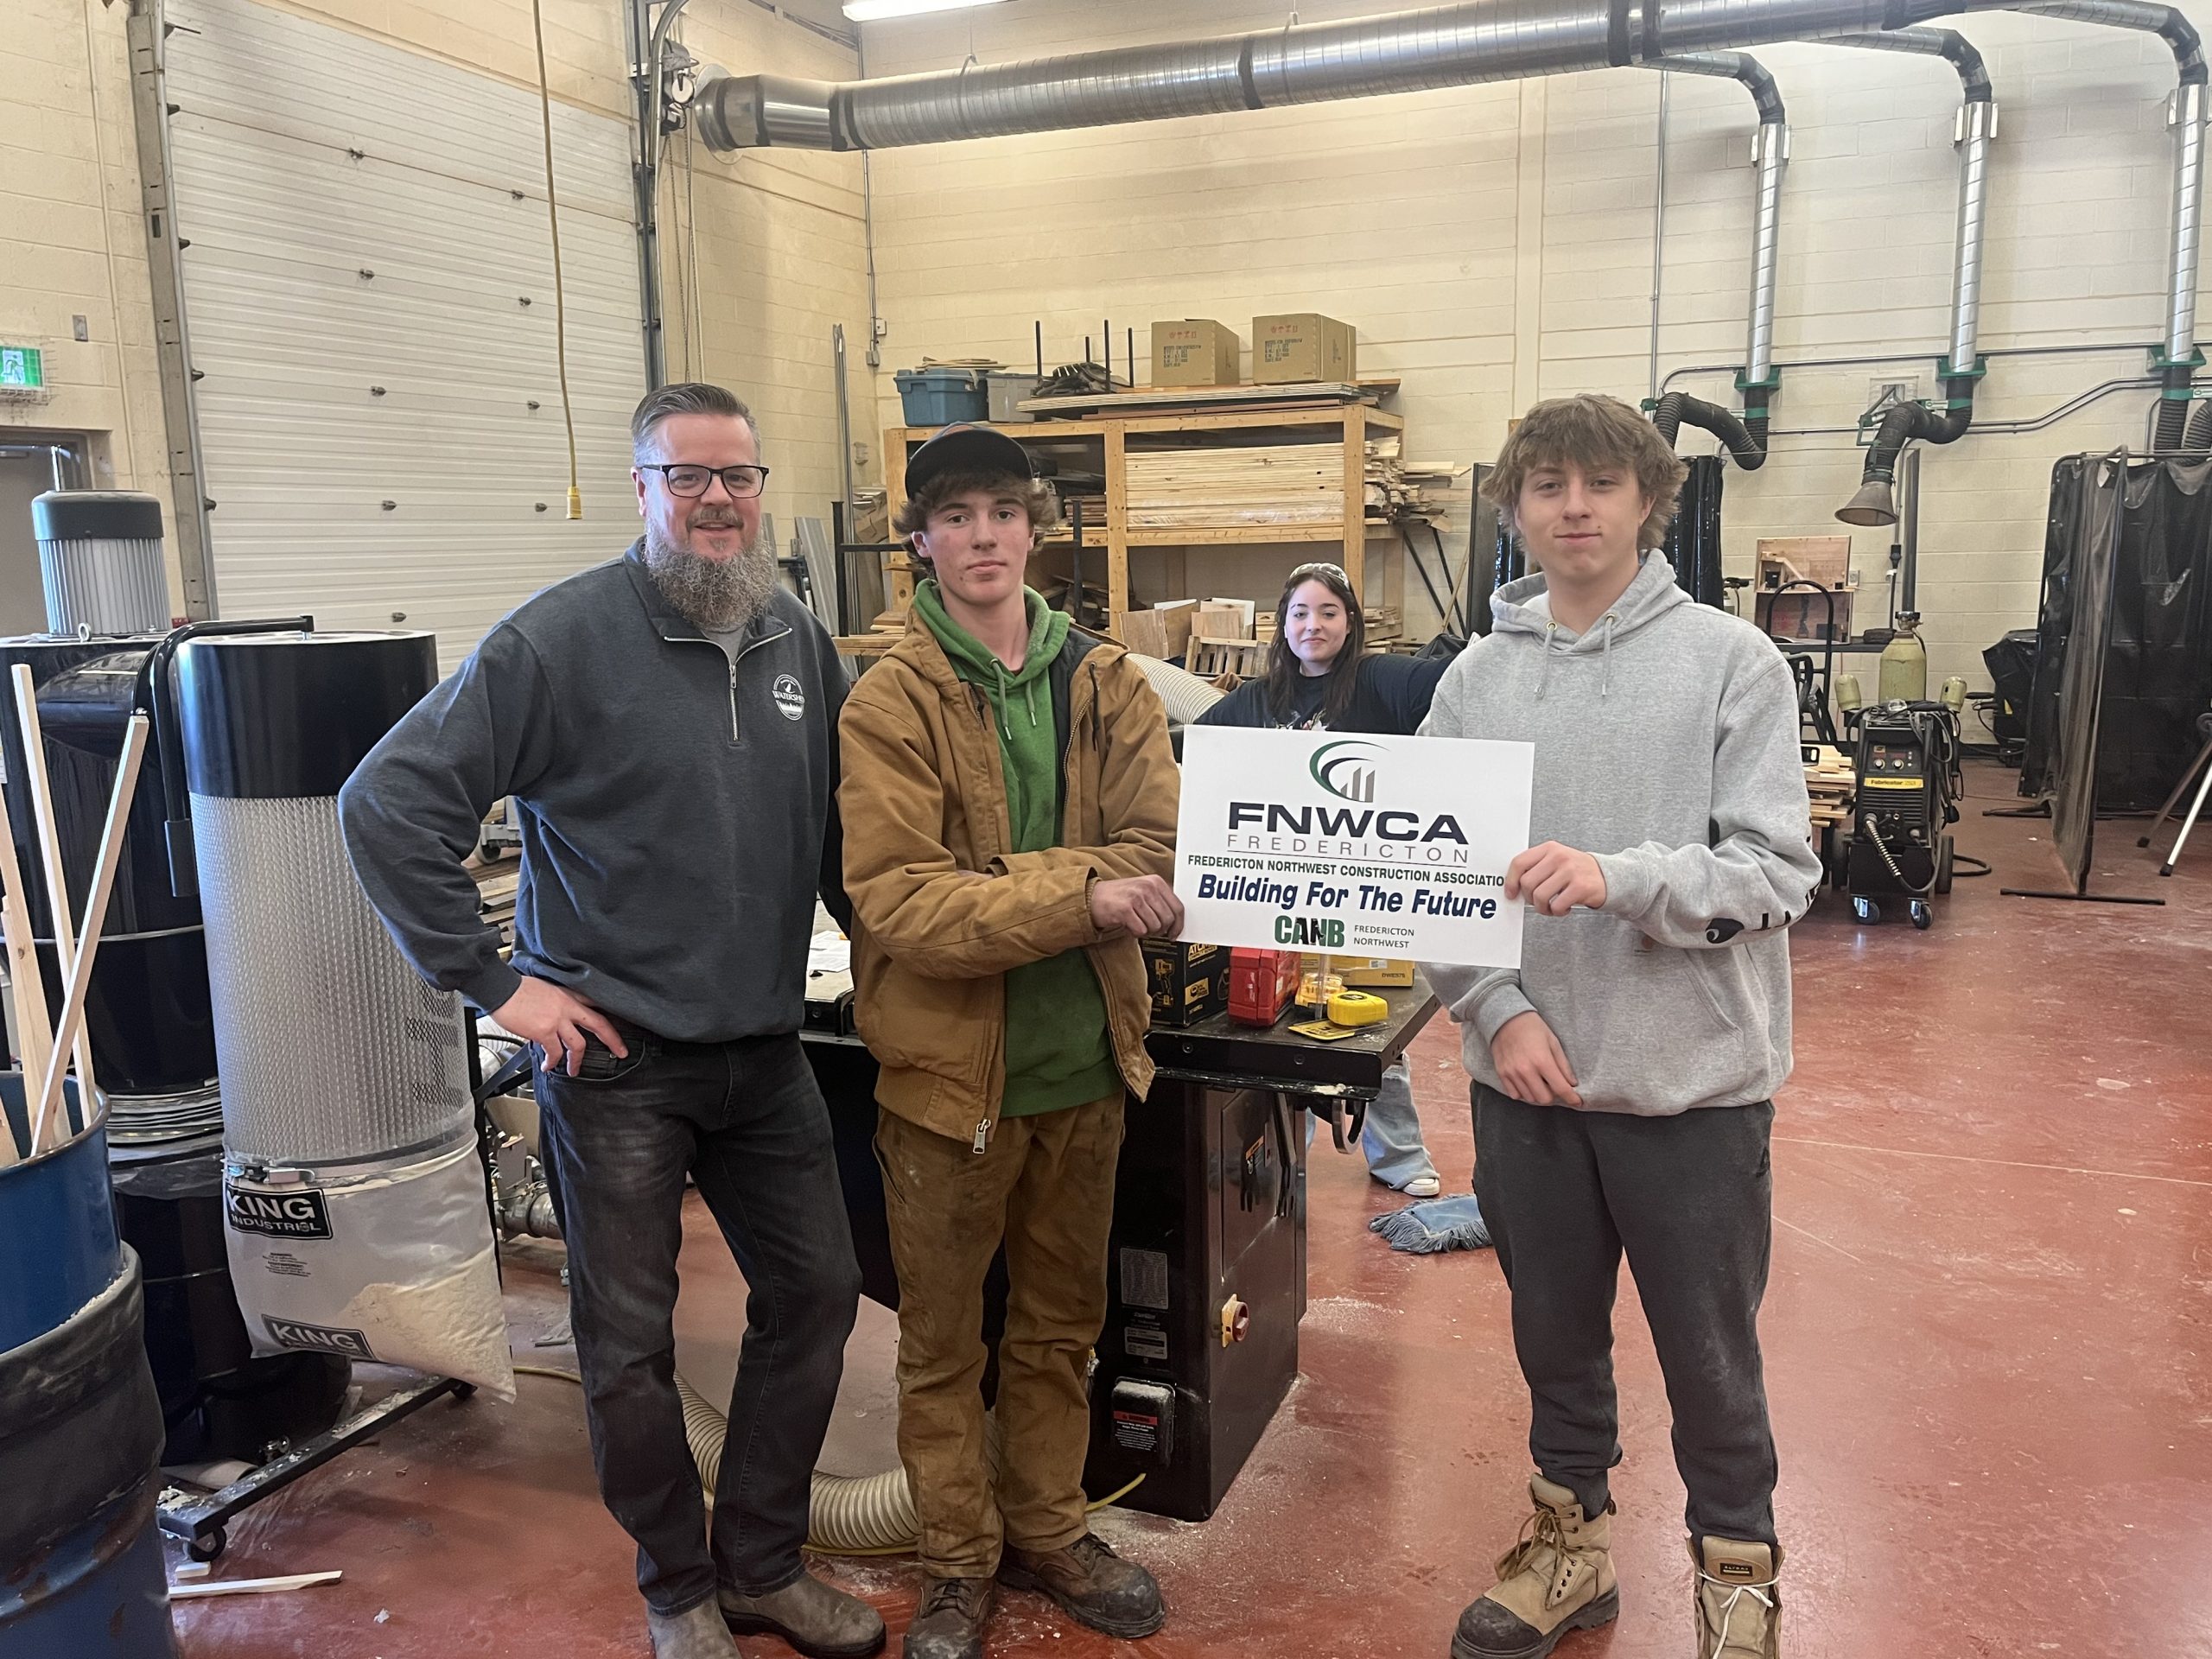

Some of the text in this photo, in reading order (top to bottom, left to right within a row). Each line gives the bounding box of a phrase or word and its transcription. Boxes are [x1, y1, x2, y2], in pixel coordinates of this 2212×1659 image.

[1228, 801, 1470, 845] FNWCA
[1228, 834, 1468, 863] FREDERICTON
[1188, 855, 1505, 887] FREDERICTON NORTHWEST CONSTRUCTION ASSOCIATIO
[1198, 874, 1497, 919] Building For The Future
[1274, 915, 1345, 948] CANB
[1353, 937, 1410, 949] NORTHWEST
[1354, 925, 1414, 937] FREDERICTON
[226, 1189, 316, 1220] KING
[272, 1322, 360, 1351] KING
